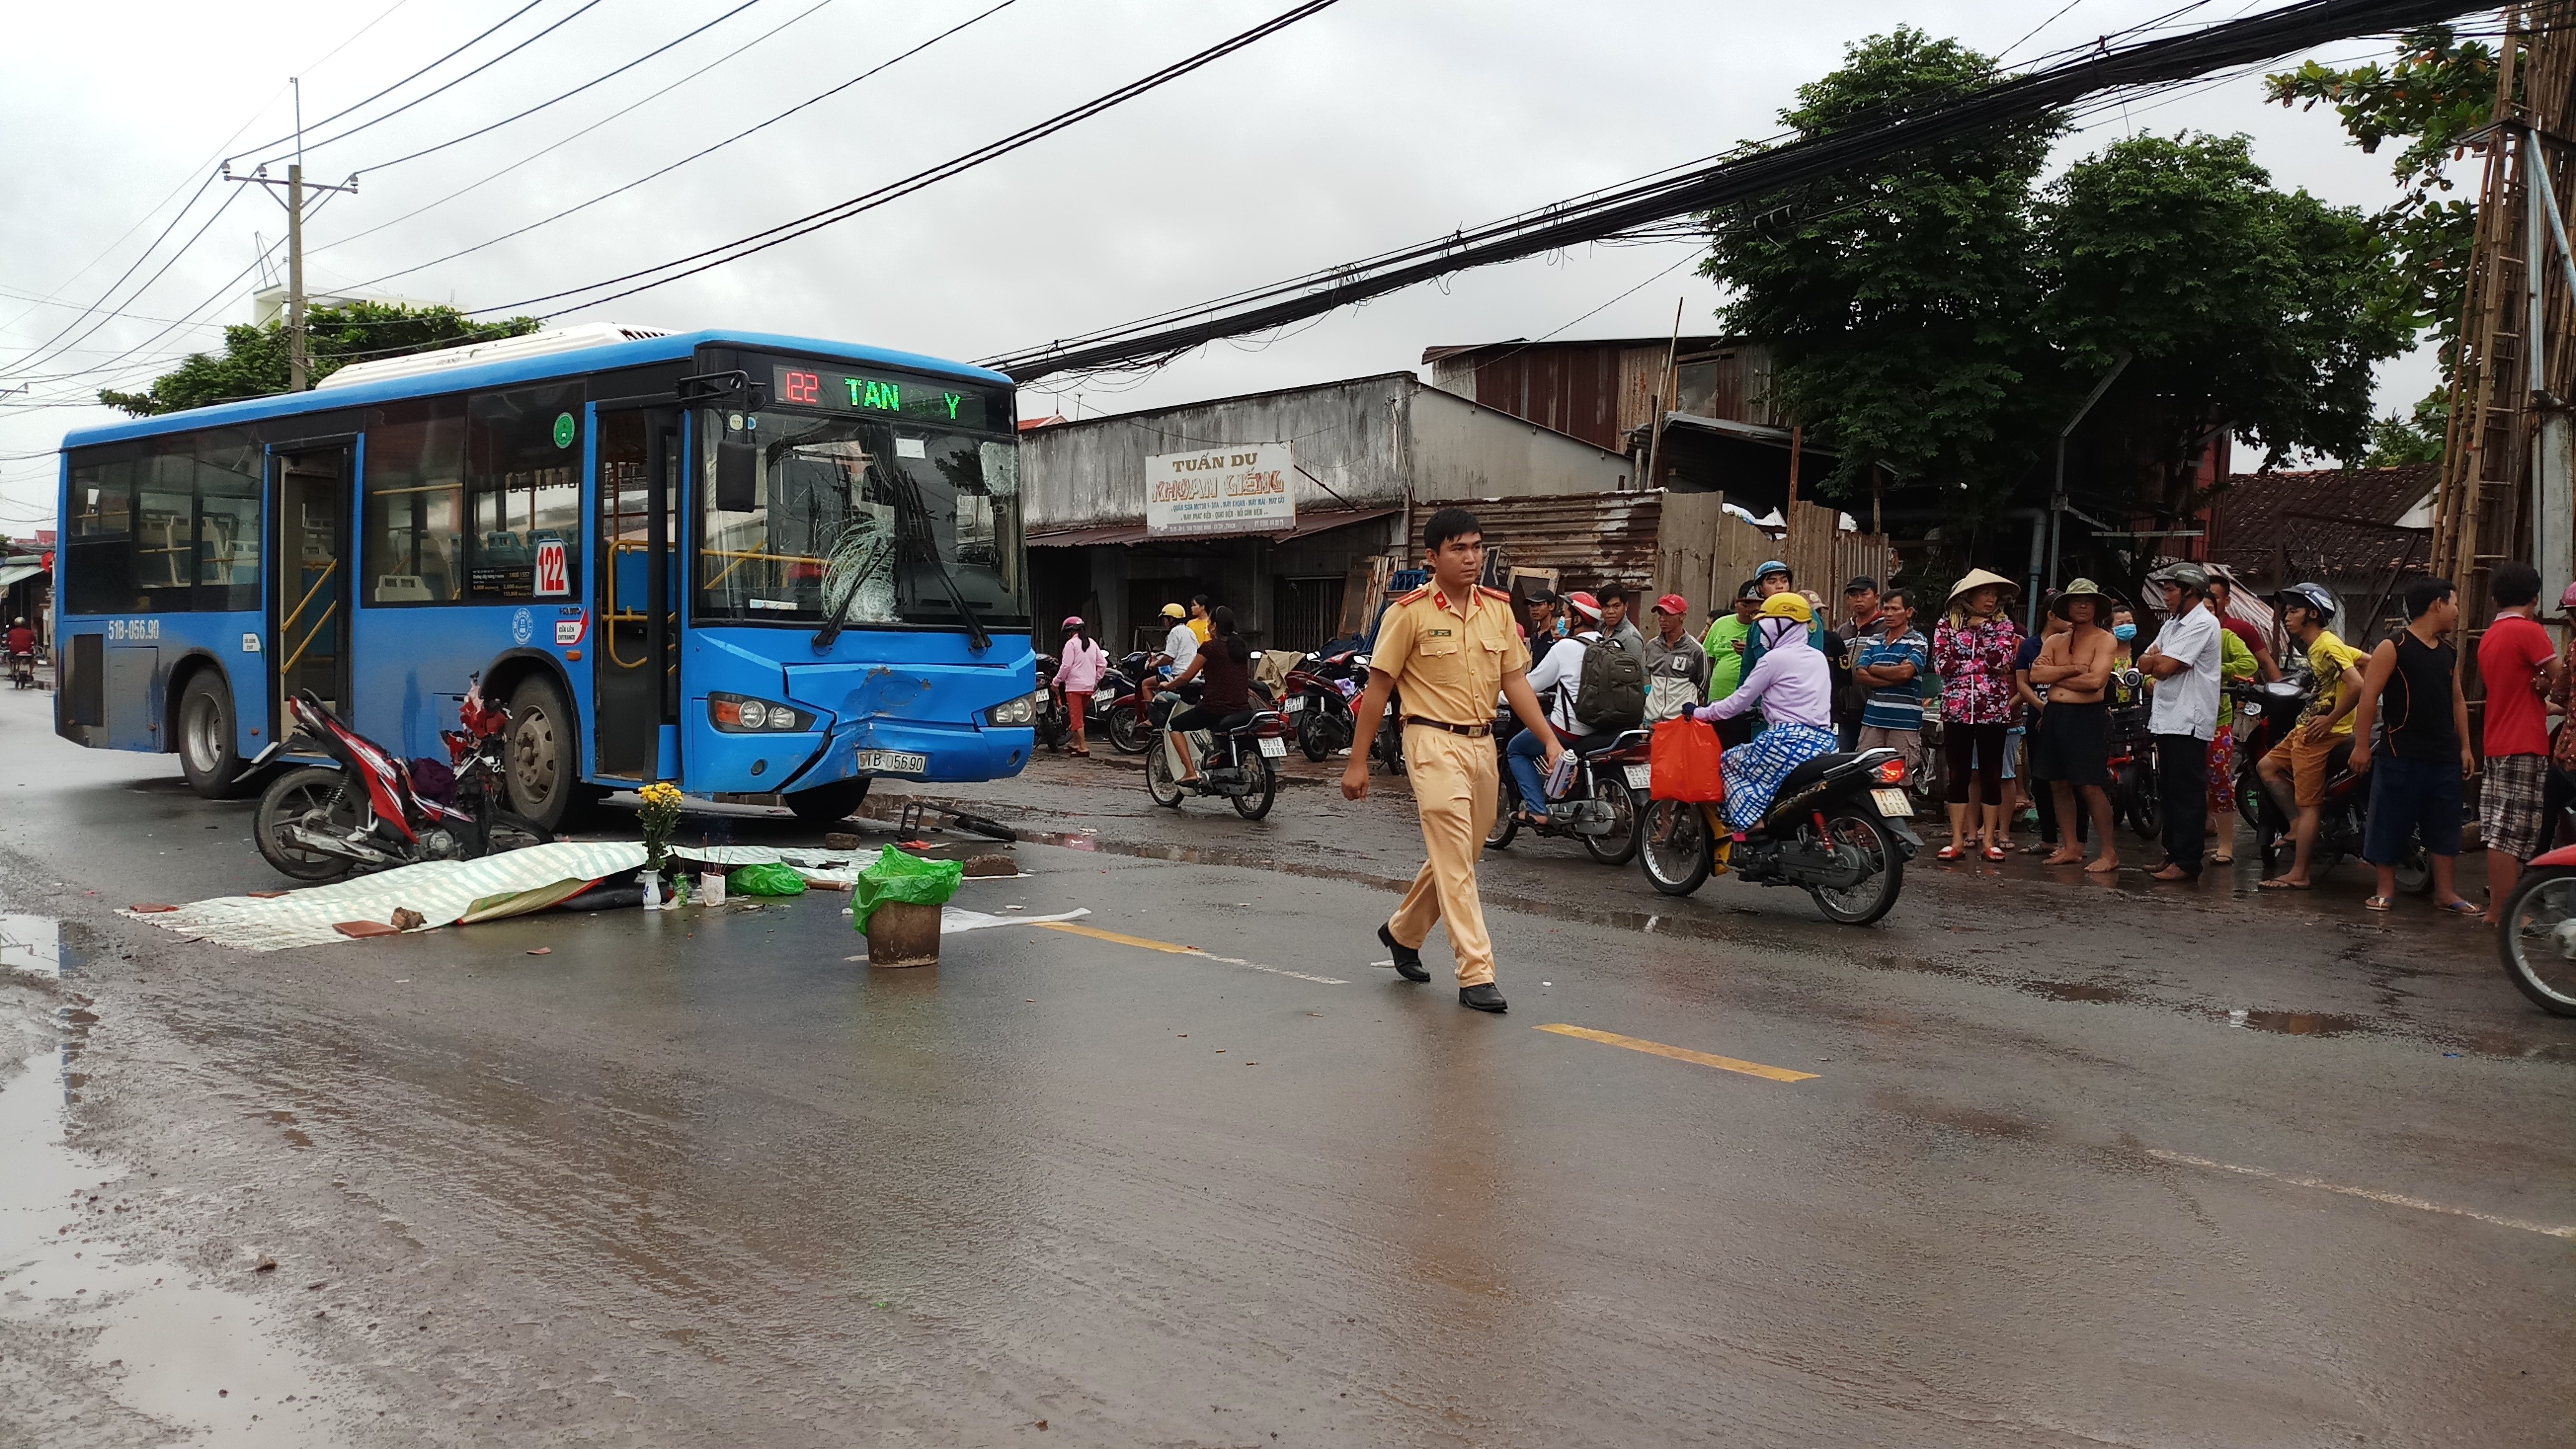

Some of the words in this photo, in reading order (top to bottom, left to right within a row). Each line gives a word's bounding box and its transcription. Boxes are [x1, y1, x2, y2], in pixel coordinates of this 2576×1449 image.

[786, 372, 819, 402] 122
[844, 377, 900, 412] TAN
[1173, 452, 1225, 472] TUẤN
[1231, 452, 1258, 467] DU
[1152, 477, 1218, 503] KHOAN
[539, 546, 564, 591] 122
[109, 619, 159, 640] 51B-056.90
